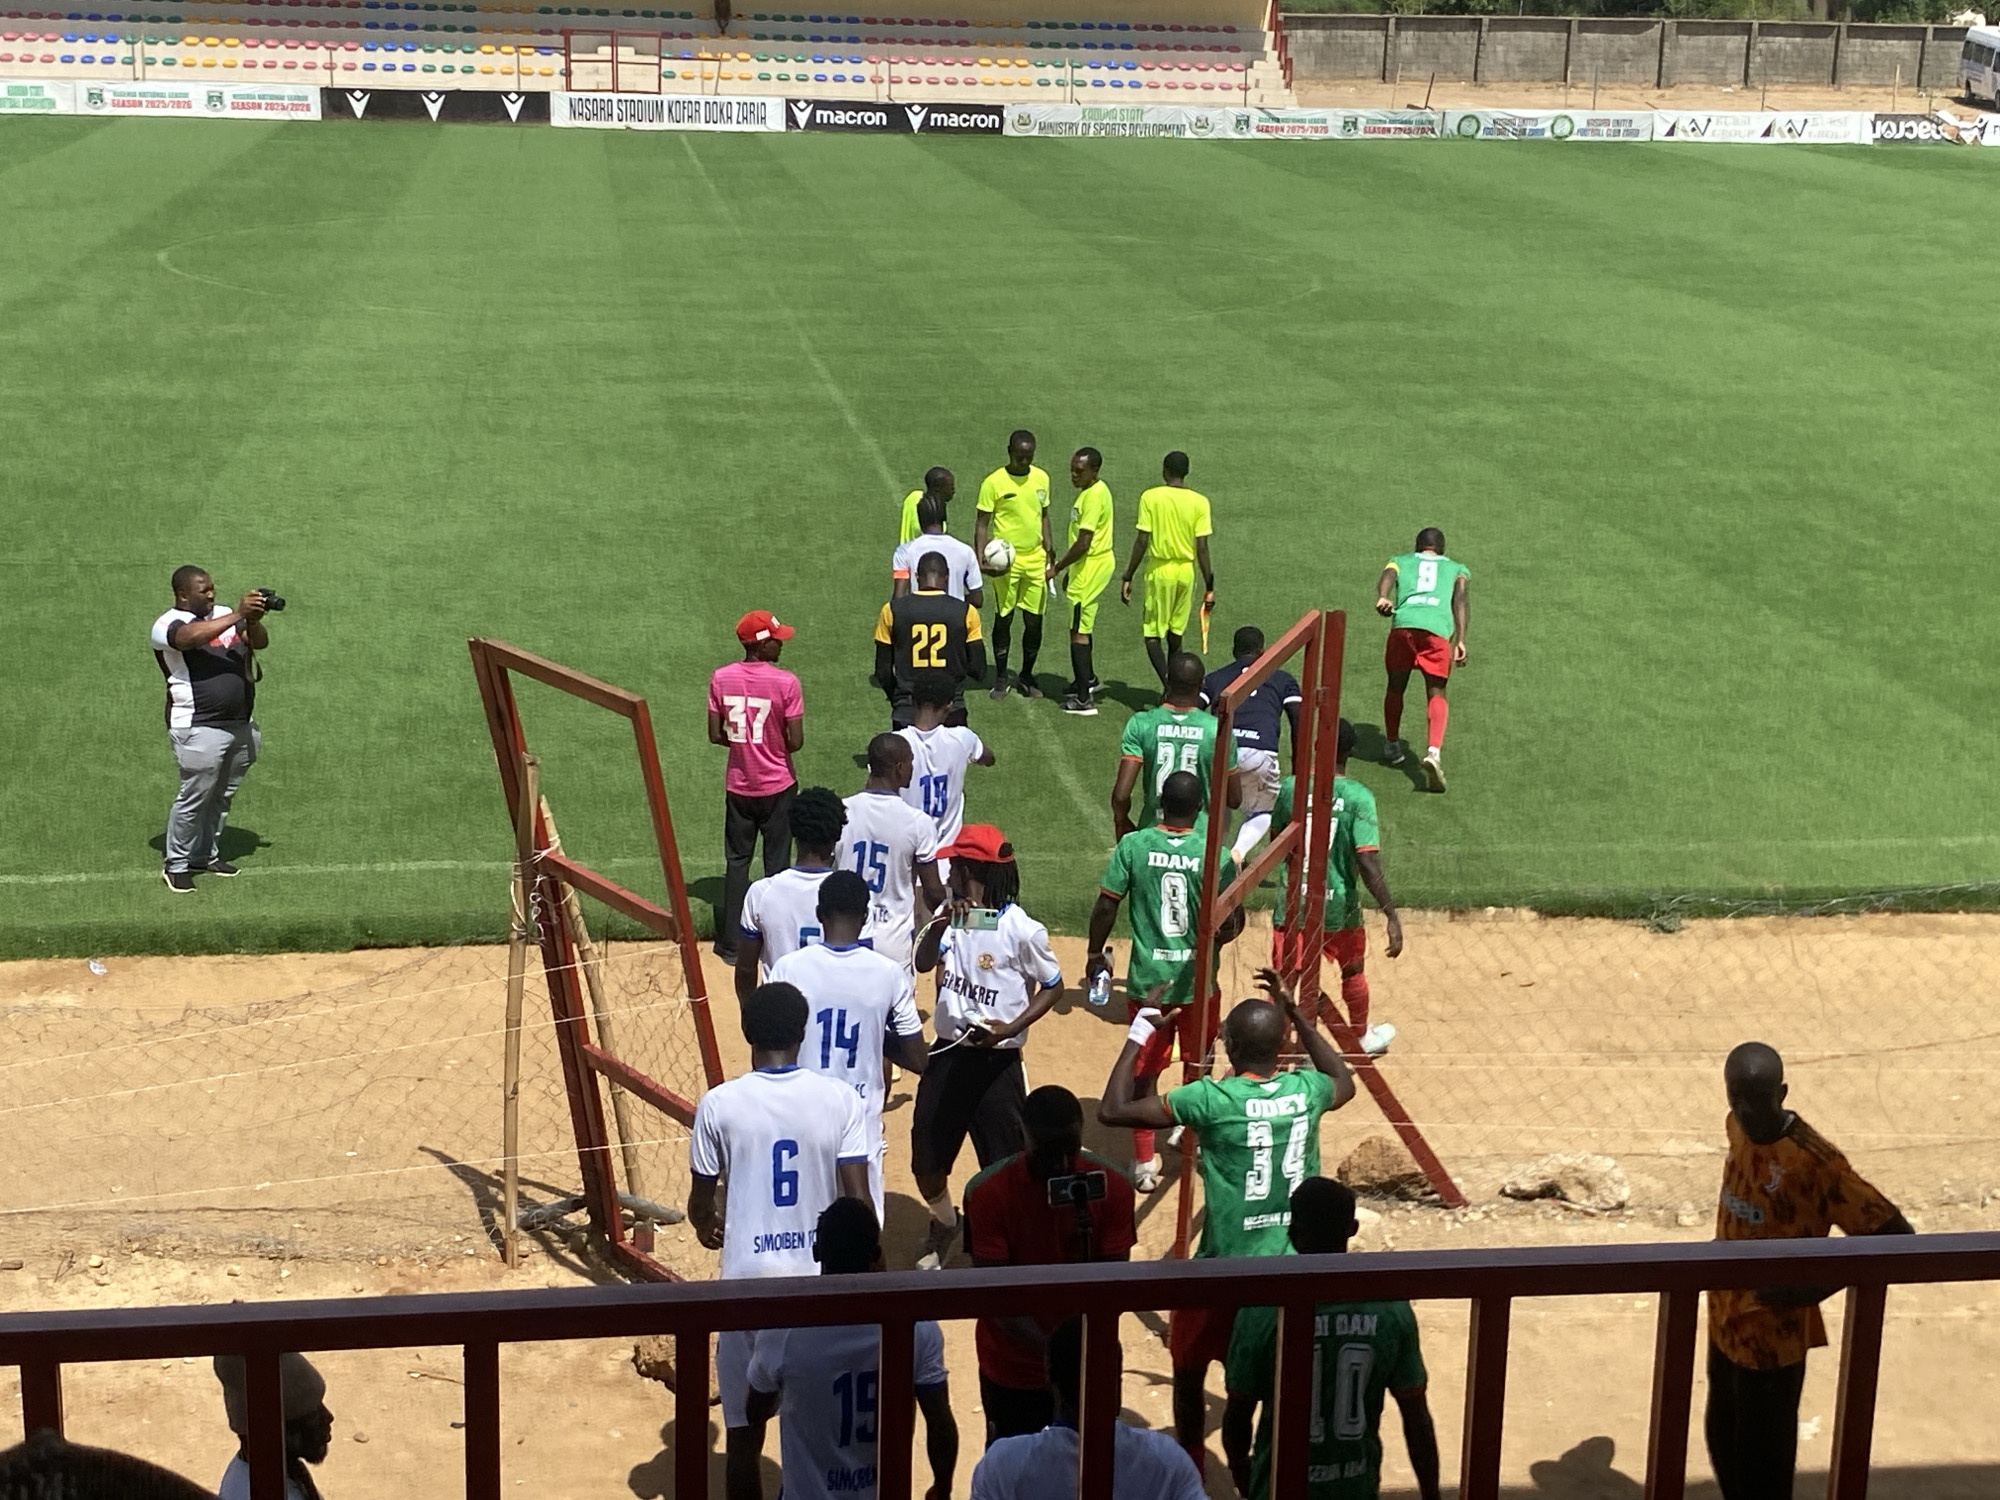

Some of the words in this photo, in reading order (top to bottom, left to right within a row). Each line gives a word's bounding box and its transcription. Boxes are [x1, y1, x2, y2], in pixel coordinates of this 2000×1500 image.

[111, 99, 143, 108] SEASON
[231, 101, 262, 110] SEASON
[569, 97, 613, 122] NASARA
[617, 98, 664, 123] STADIUM
[668, 100, 701, 124] KOFAR
[704, 101, 732, 124] DOKA
[736, 102, 766, 125] ZARIA
[1081, 107, 1118, 121] KADUNA
[1119, 108, 1144, 122] STATE
[815, 110, 887, 126] macron
[930, 112, 1000, 128] macron
[1038, 121, 1079, 135] MINISTRY
[1081, 122, 1090, 136] OF
[1093, 122, 1127, 136] SPORTS
[912, 623, 947, 668] 22
[722, 696, 772, 744] 37
[853, 840, 889, 894] 15
[1148, 852, 1201, 872] IDAM
[1161, 872, 1188, 937] 8
[816, 1008, 860, 1069] 14
[1245, 1093, 1307, 1118] ODEY
[1244, 1115, 1309, 1201] 34
[773, 1139, 799, 1207] 6
